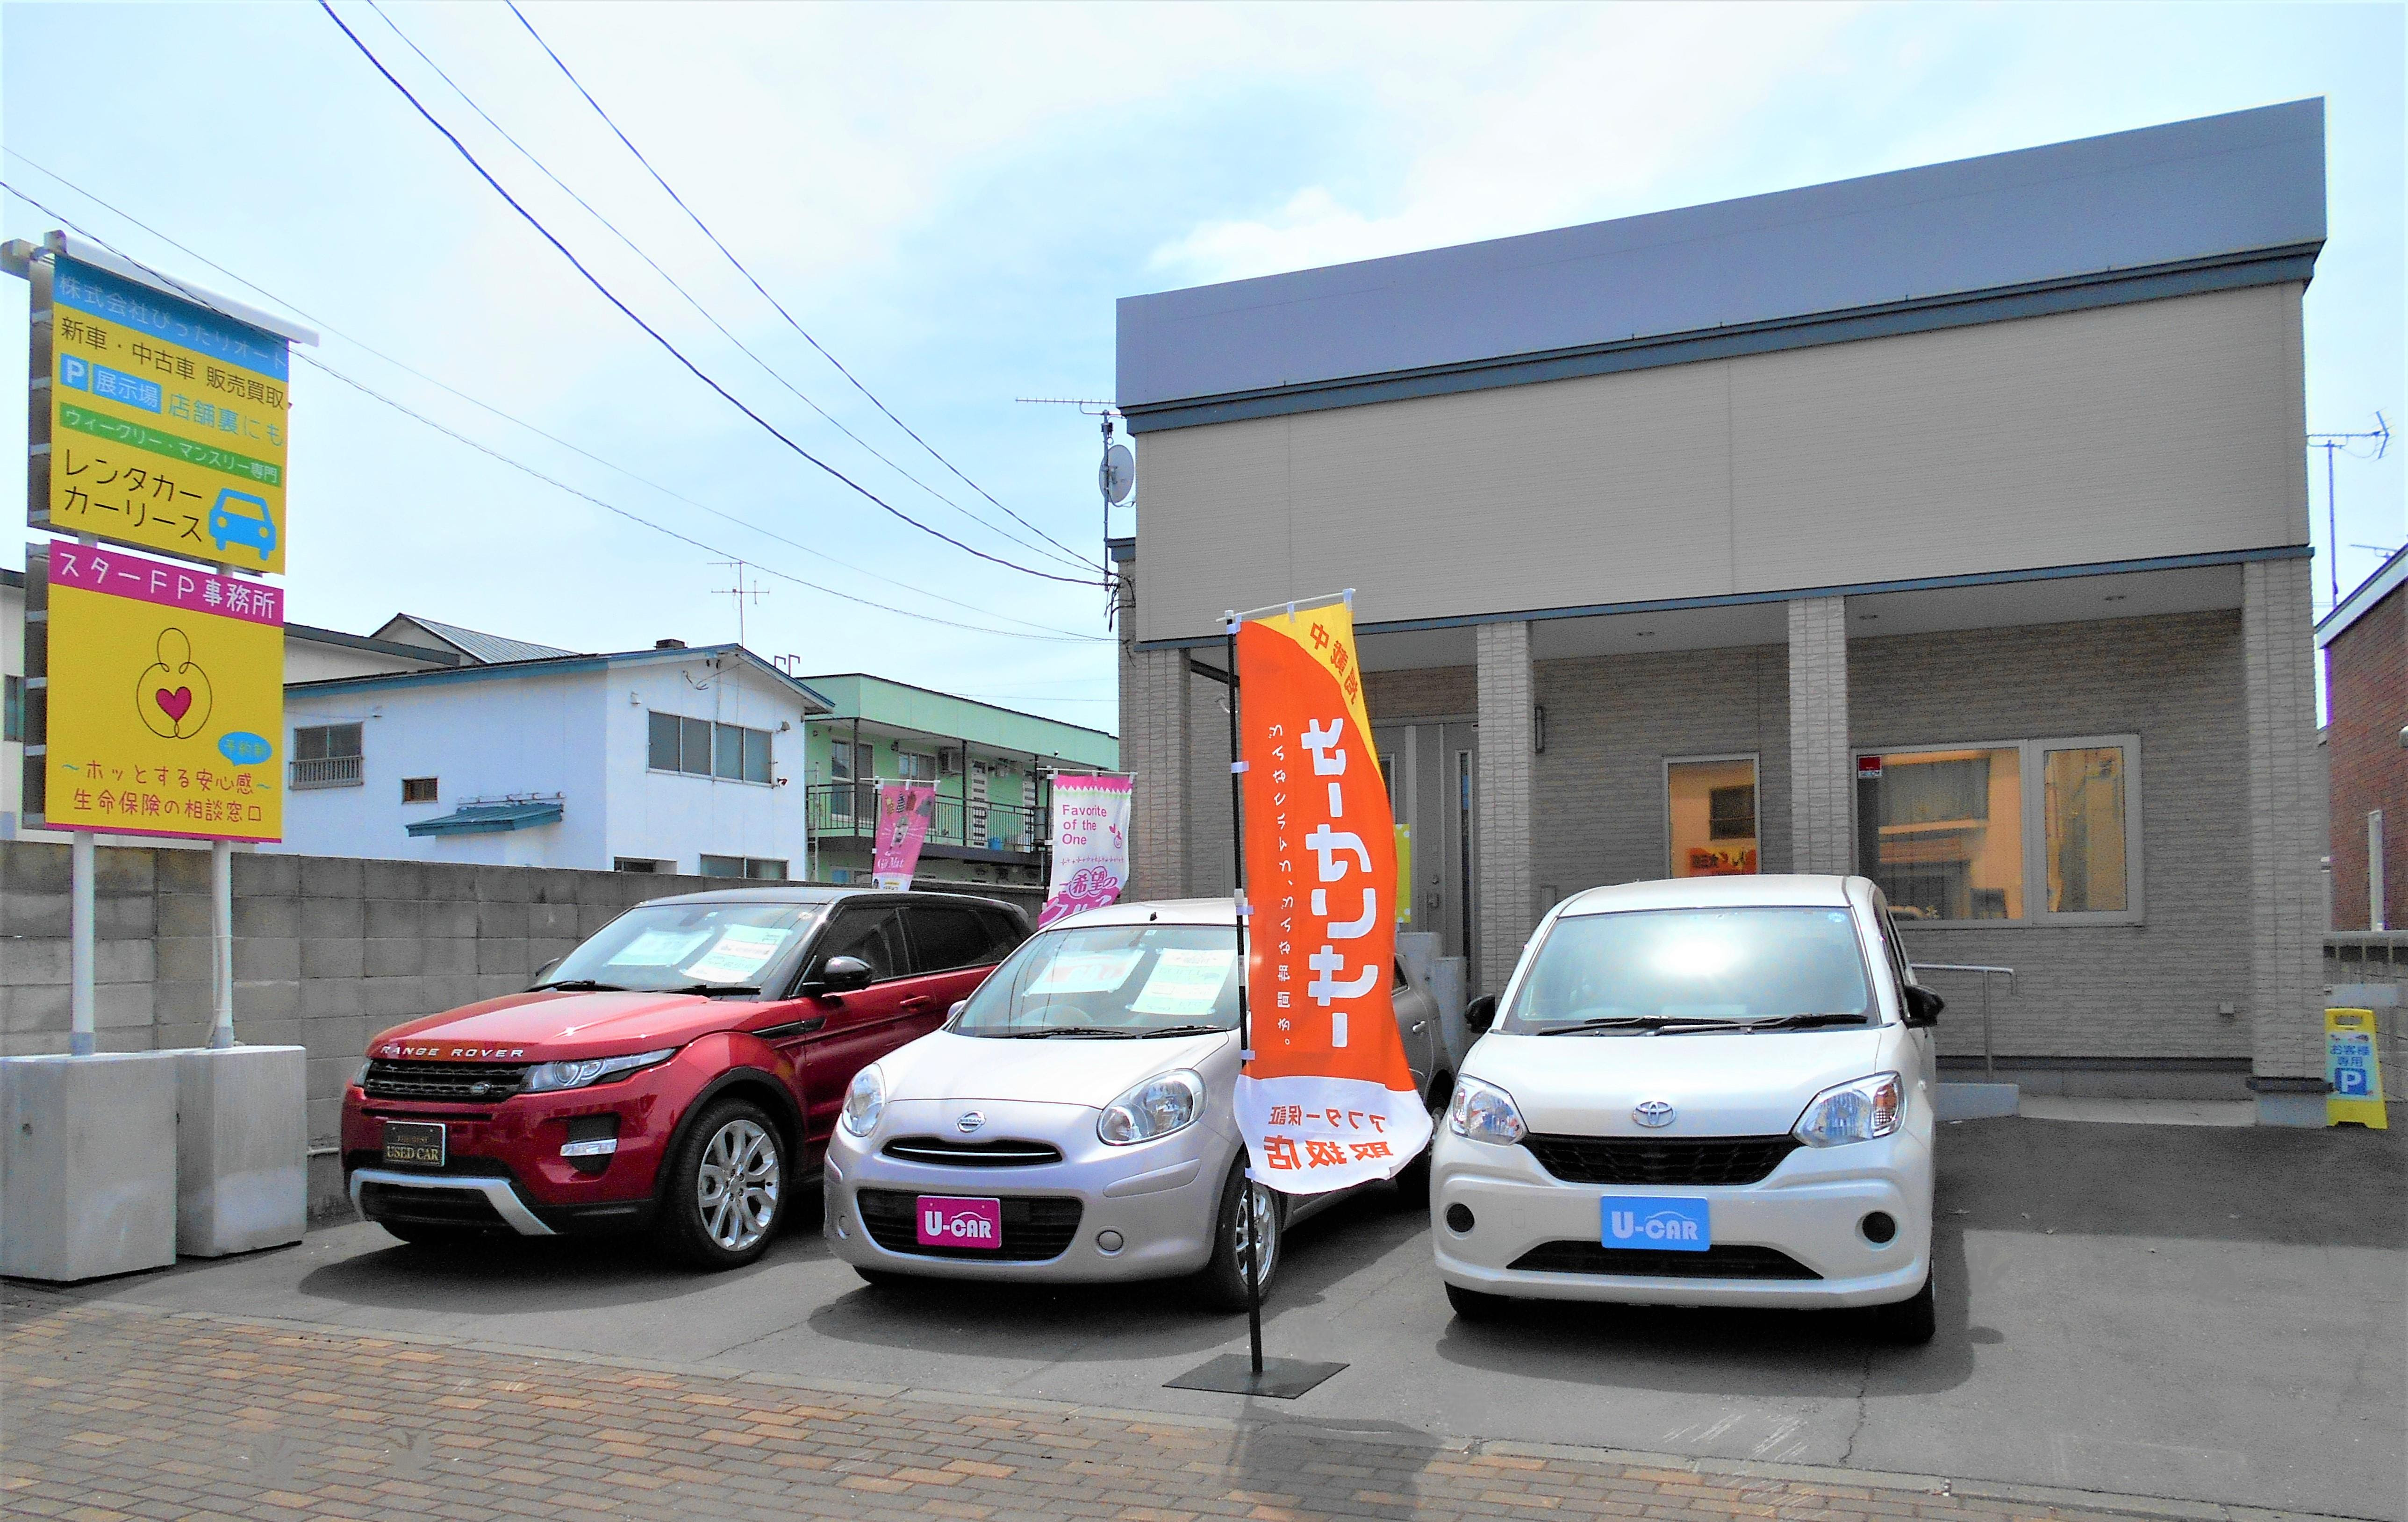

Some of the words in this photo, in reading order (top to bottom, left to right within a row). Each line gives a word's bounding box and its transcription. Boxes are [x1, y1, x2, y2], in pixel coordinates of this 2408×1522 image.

[62, 317, 195, 379] 新車・中古車
[207, 366, 283, 410] 販売買取
[67, 359, 85, 384] P
[97, 371, 158, 407] 展示場
[169, 393, 283, 446] 店舗裏にも
[66, 449, 202, 501] レンタカー
[64, 486, 202, 543] カーリース
[73, 788, 262, 822] 生命保険の相談窓口
[1062, 804, 1107, 817] Favorite
[1063, 819, 1077, 830] of
[1082, 819, 1096, 830] the
[1062, 833, 1087, 845] One
[380, 1046, 440, 1056] RANGE
[451, 1048, 524, 1058] ROVER
[2341, 1070, 2361, 1093] P
[387, 1146, 415, 1159] USED
[416, 1147, 438, 1161] CAR
[925, 1211, 992, 1238] U-CAR
[1612, 1211, 1698, 1240] U-CAR
